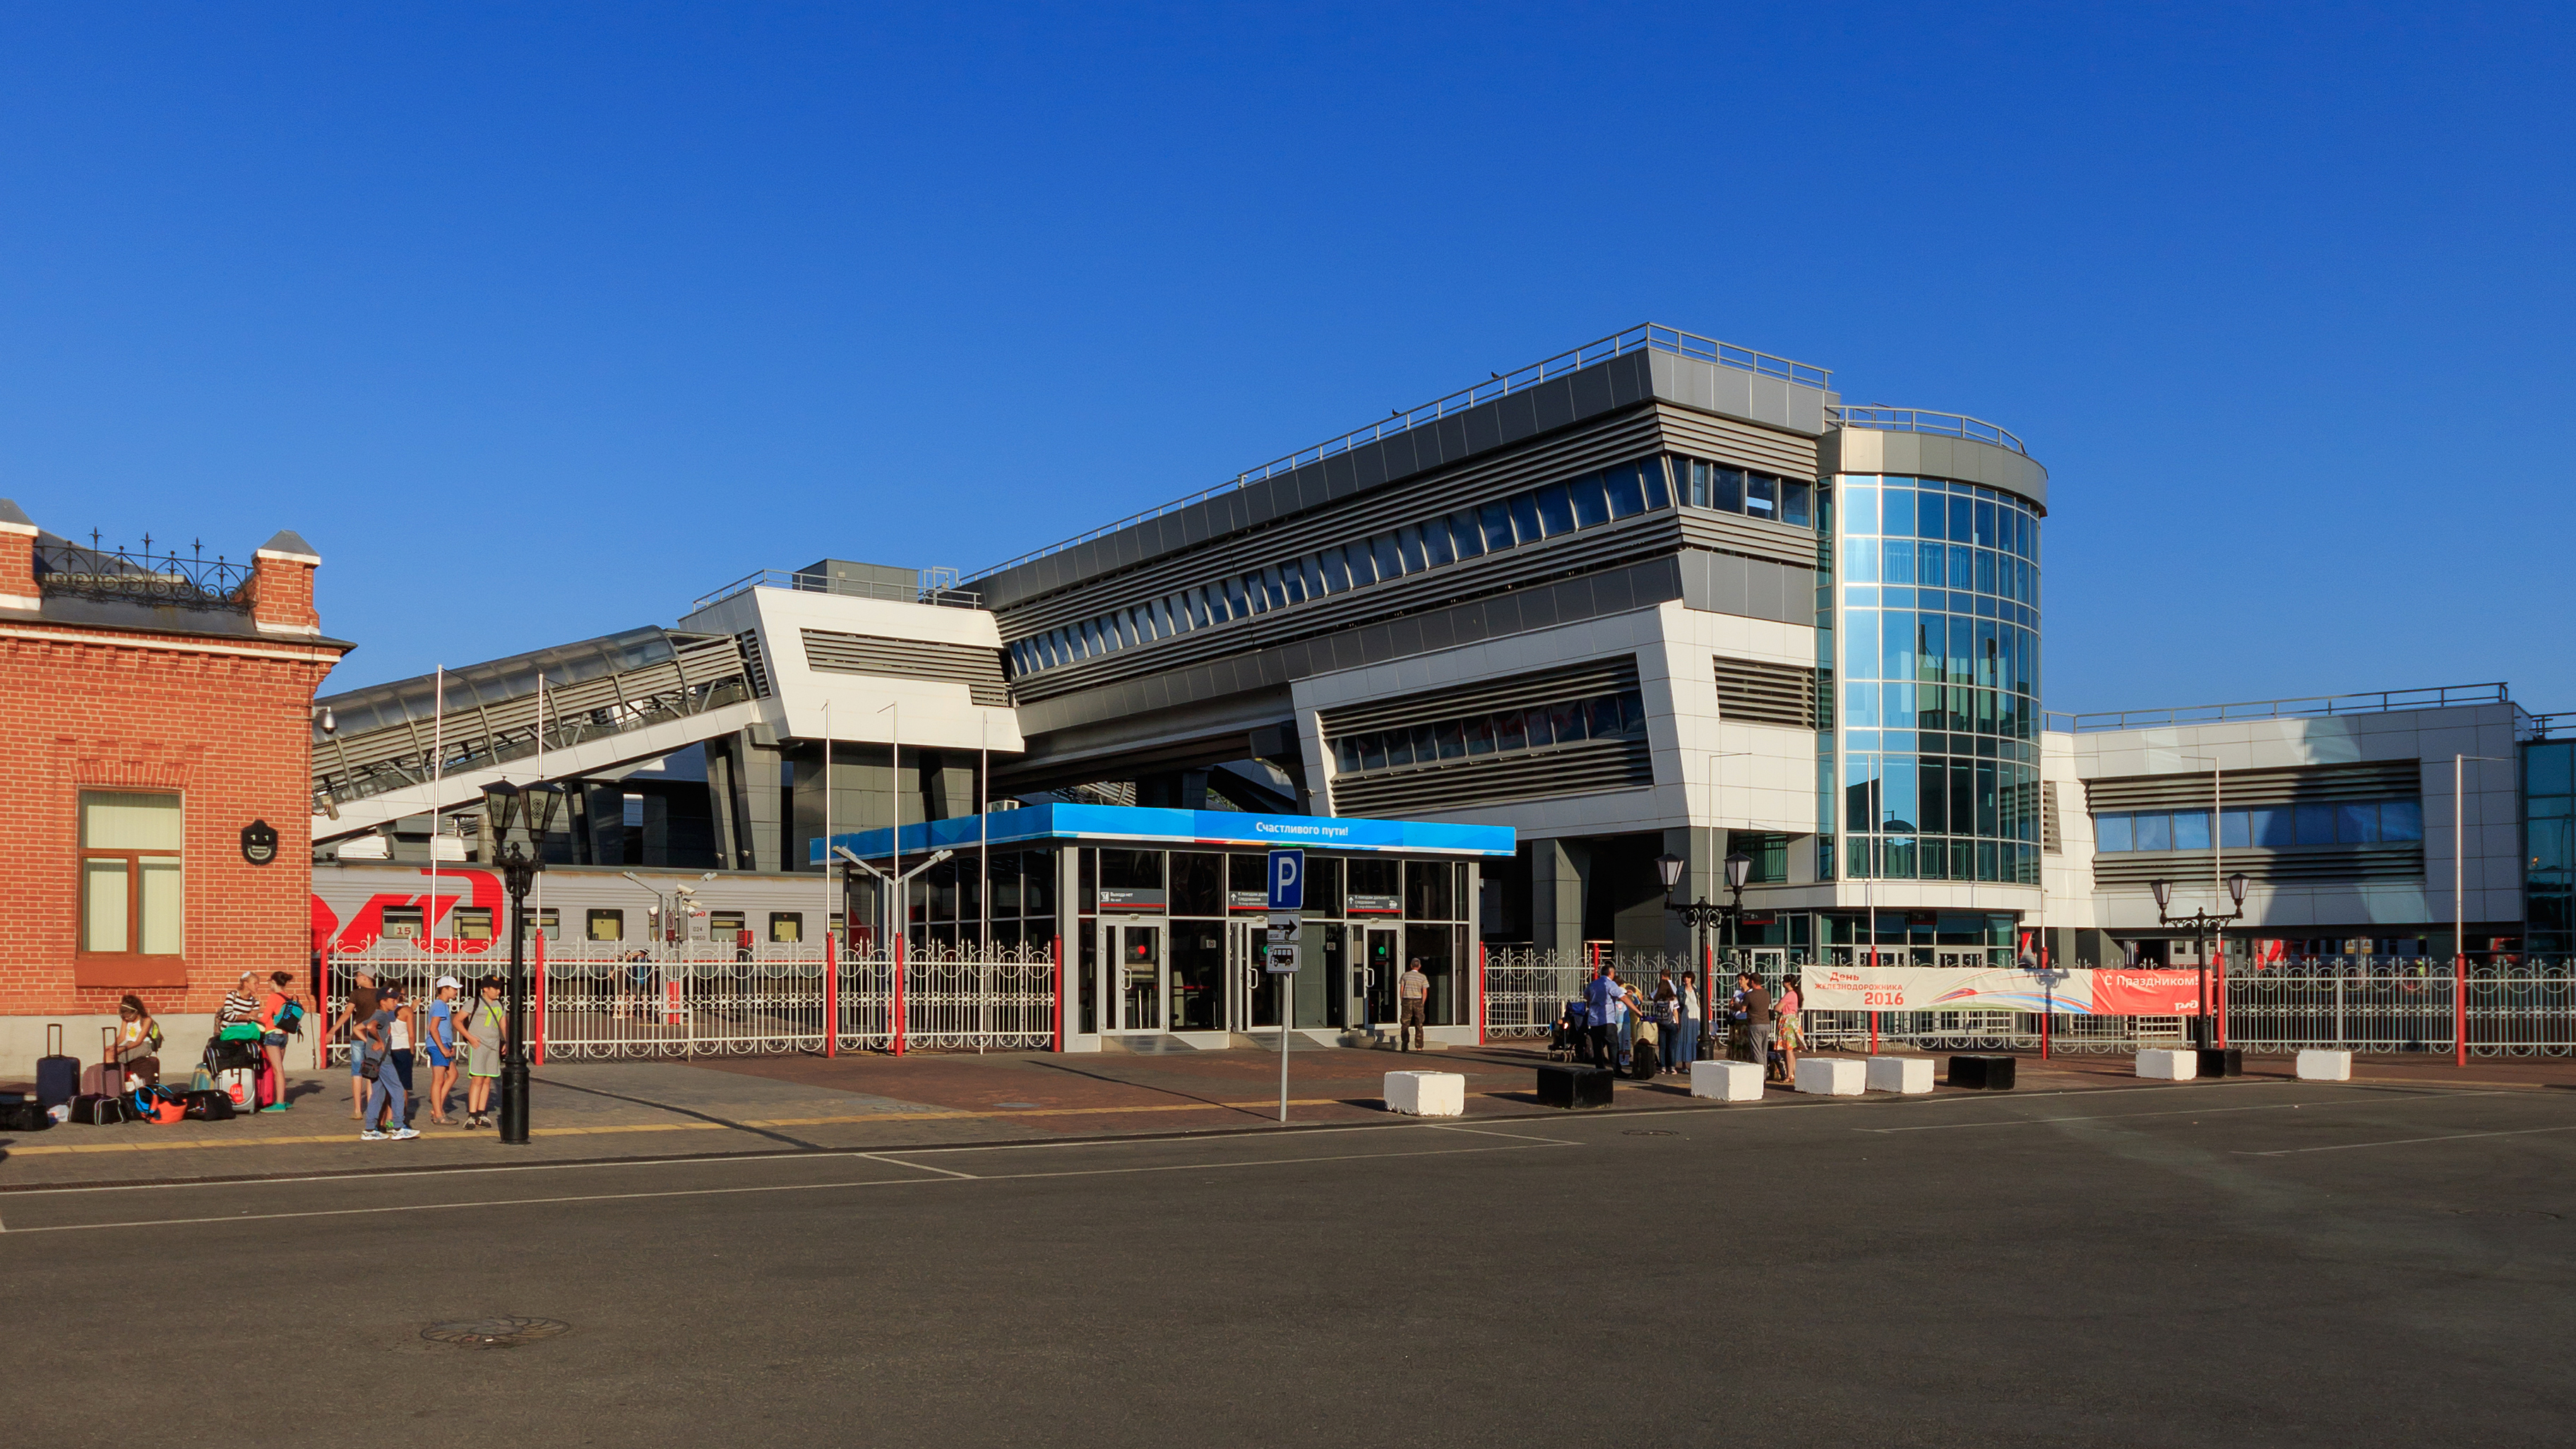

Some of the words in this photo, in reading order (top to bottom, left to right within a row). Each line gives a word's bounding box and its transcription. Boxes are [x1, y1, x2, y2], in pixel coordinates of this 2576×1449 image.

[1256, 821, 1320, 835] Счастливого
[1322, 826, 1349, 838] пути!
[396, 926, 412, 935] 15
[1830, 972, 1860, 982] День
[2104, 974, 2113, 986] С
[2116, 974, 2199, 988] Праздником!
[1814, 983, 1904, 991] ЖЕЛЕЗНОДОРОЖНИКА
[1864, 991, 1904, 1006] 2016
